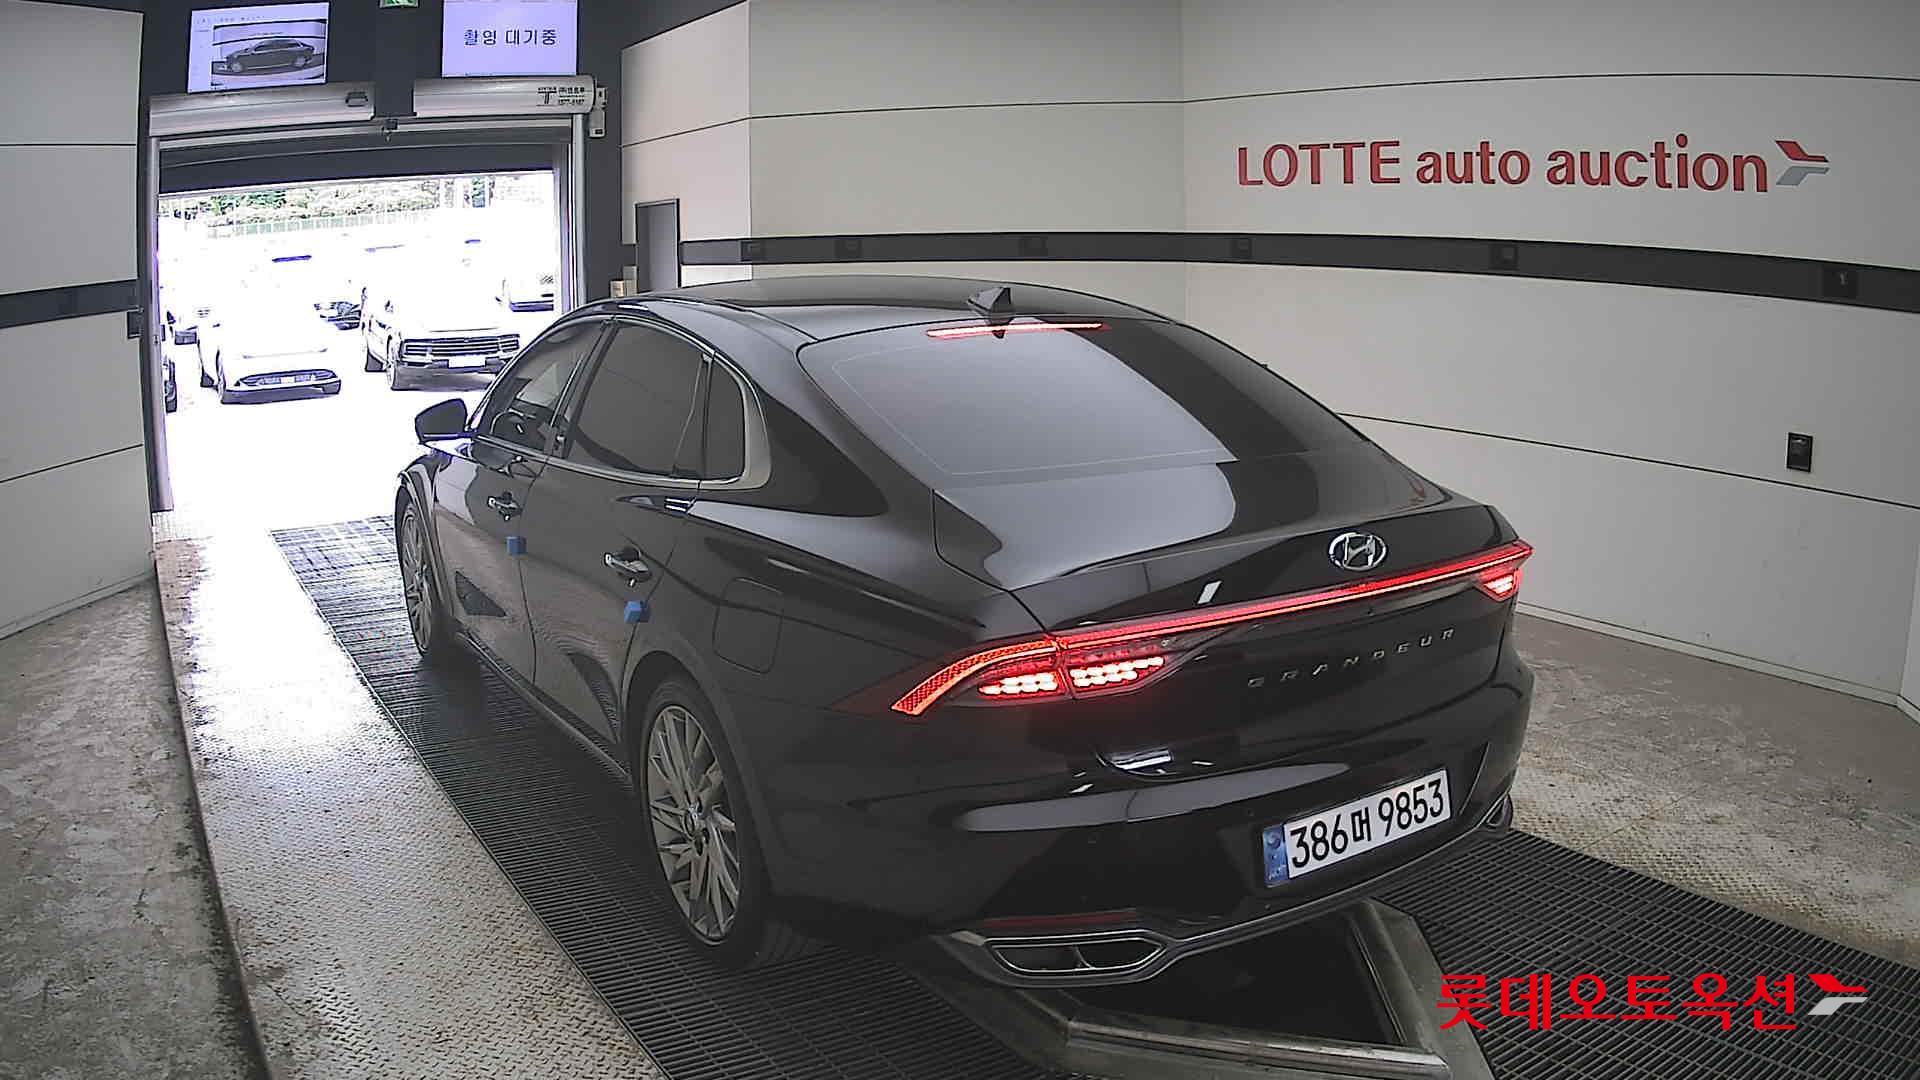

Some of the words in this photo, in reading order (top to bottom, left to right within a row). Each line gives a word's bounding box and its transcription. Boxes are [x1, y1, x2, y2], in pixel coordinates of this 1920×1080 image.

[505, 29, 557, 46] 대기중
[1237, 140, 1400, 187] LOTTE
[1416, 140, 1530, 185] auto
[1546, 133, 1768, 193] auction
[1247, 627, 1454, 688] GRANDEUR
[1290, 806, 1372, 868] 386머
[1378, 778, 1444, 837] 9853
